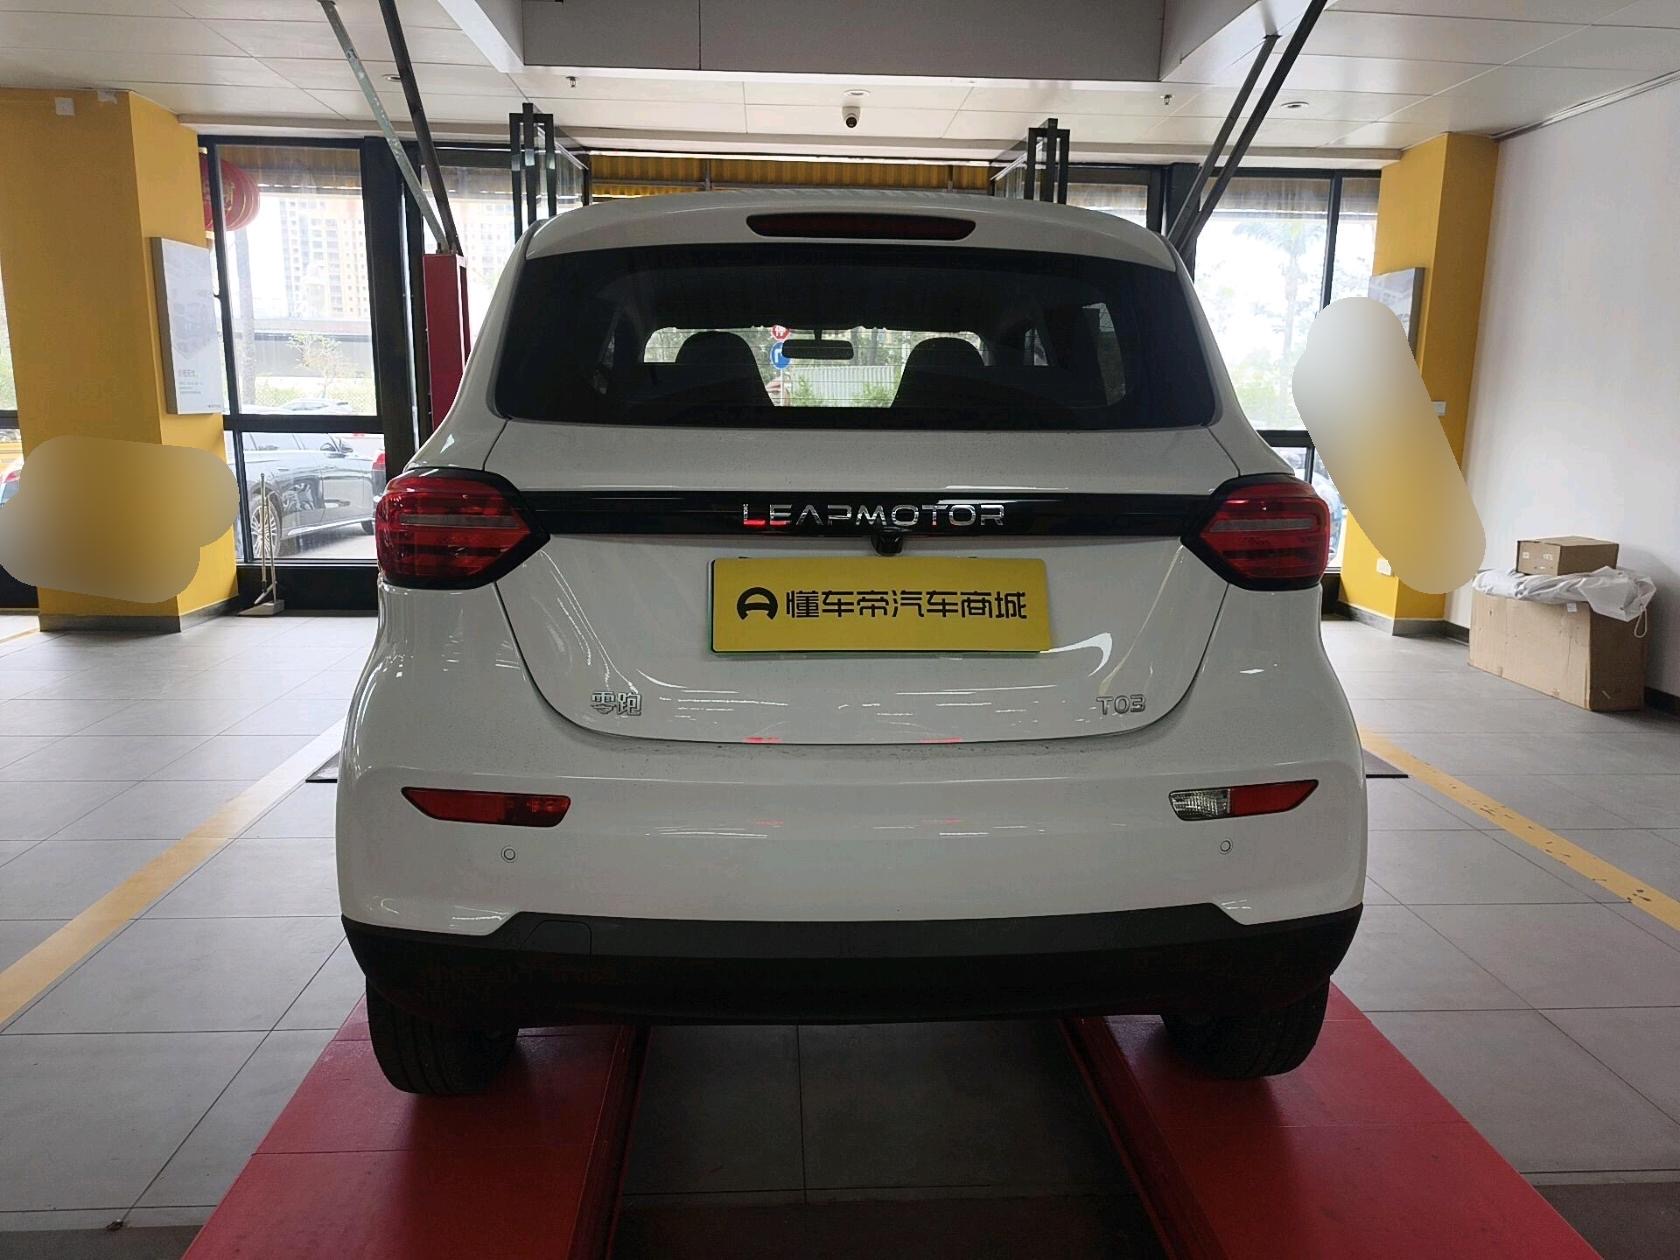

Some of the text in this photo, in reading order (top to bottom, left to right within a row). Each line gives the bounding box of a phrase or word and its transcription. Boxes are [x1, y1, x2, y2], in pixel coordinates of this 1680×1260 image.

[743, 503, 1006, 527] LEAPMOTOR
[786, 589, 1028, 620] 懂车帝汽车商城
[591, 690, 642, 717] 零跑
[1096, 694, 1146, 715] T03
